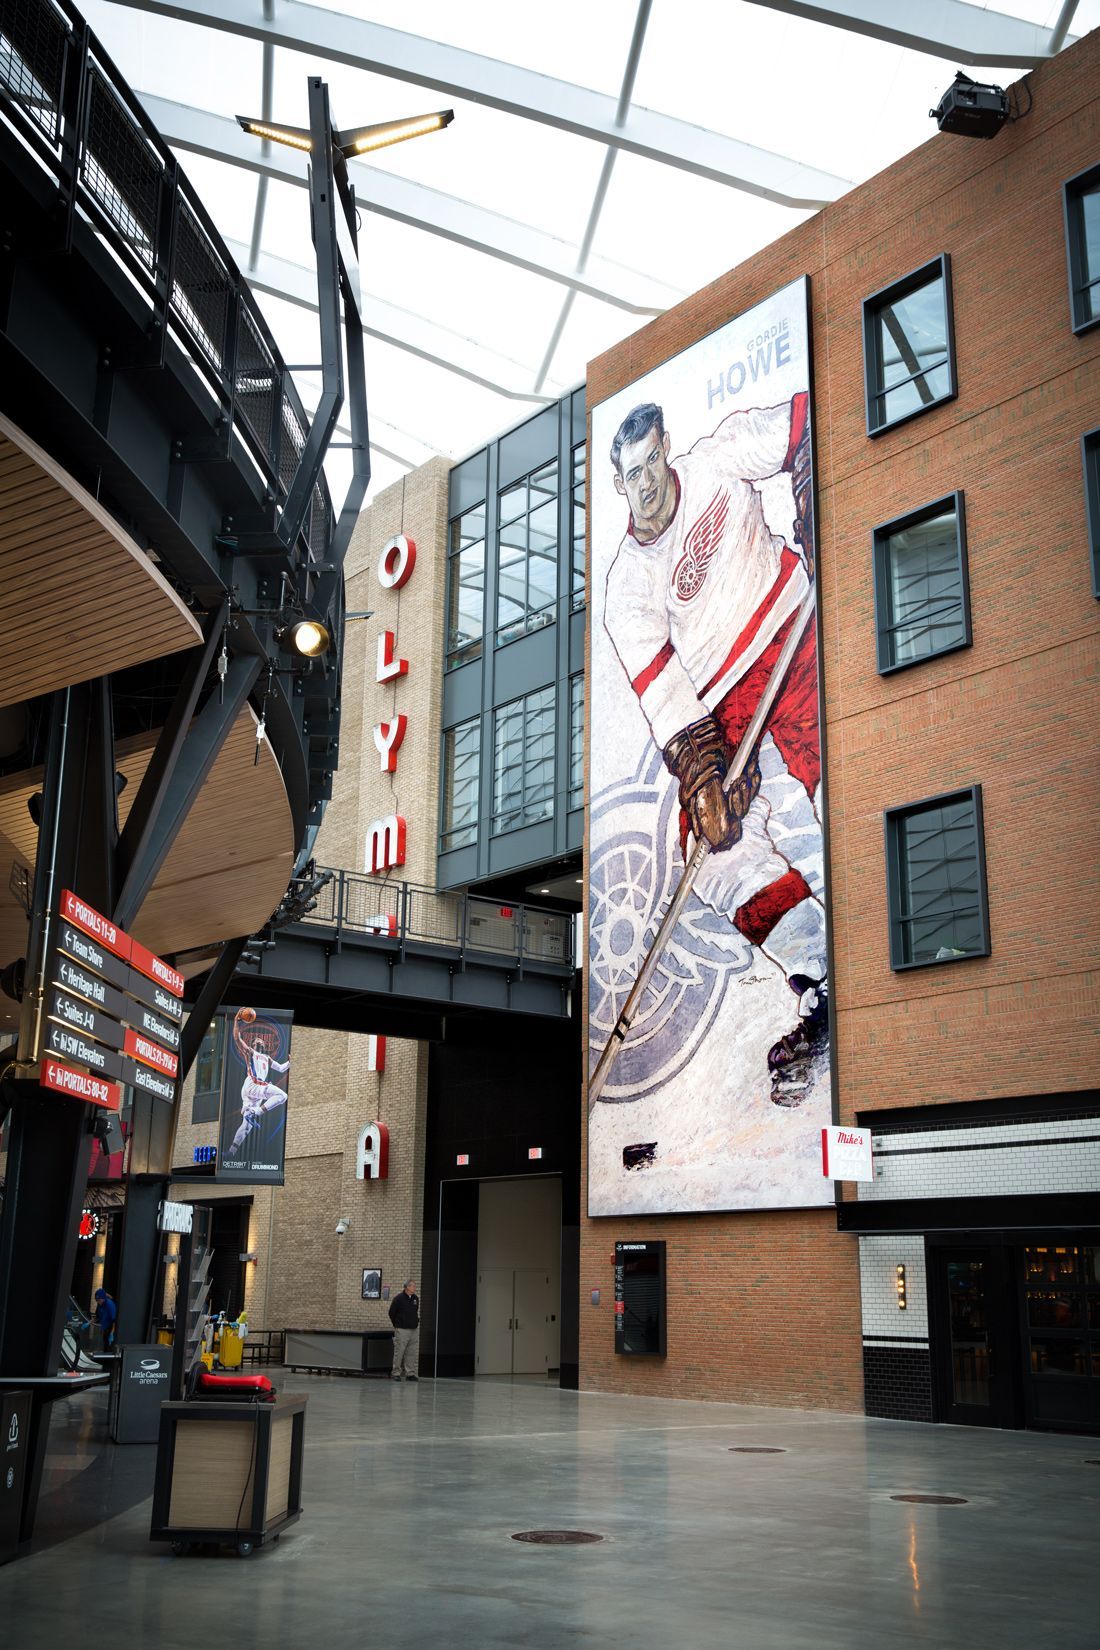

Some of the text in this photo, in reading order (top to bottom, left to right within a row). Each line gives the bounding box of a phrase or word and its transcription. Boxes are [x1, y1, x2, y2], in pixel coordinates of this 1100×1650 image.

[746, 318, 789, 352] GORDIE
[707, 331, 791, 410] HOWE
[75, 901, 100, 934] PORTALS
[72, 934, 103, 968] Team Store
[152, 958, 172, 984] PORTALS
[68, 967, 105, 1003] Heritage Hall
[154, 989, 168, 1010] Suites
[64, 1001, 83, 1024] Suites
[67, 1036, 105, 1067] SW Elevators
[135, 1037, 156, 1062] PORTALS
[63, 1071, 92, 1096] PORTALS
[135, 1068, 146, 1086] East
[837, 1131, 864, 1145] Mike's
[145, 1371, 168, 1379] Caesars
